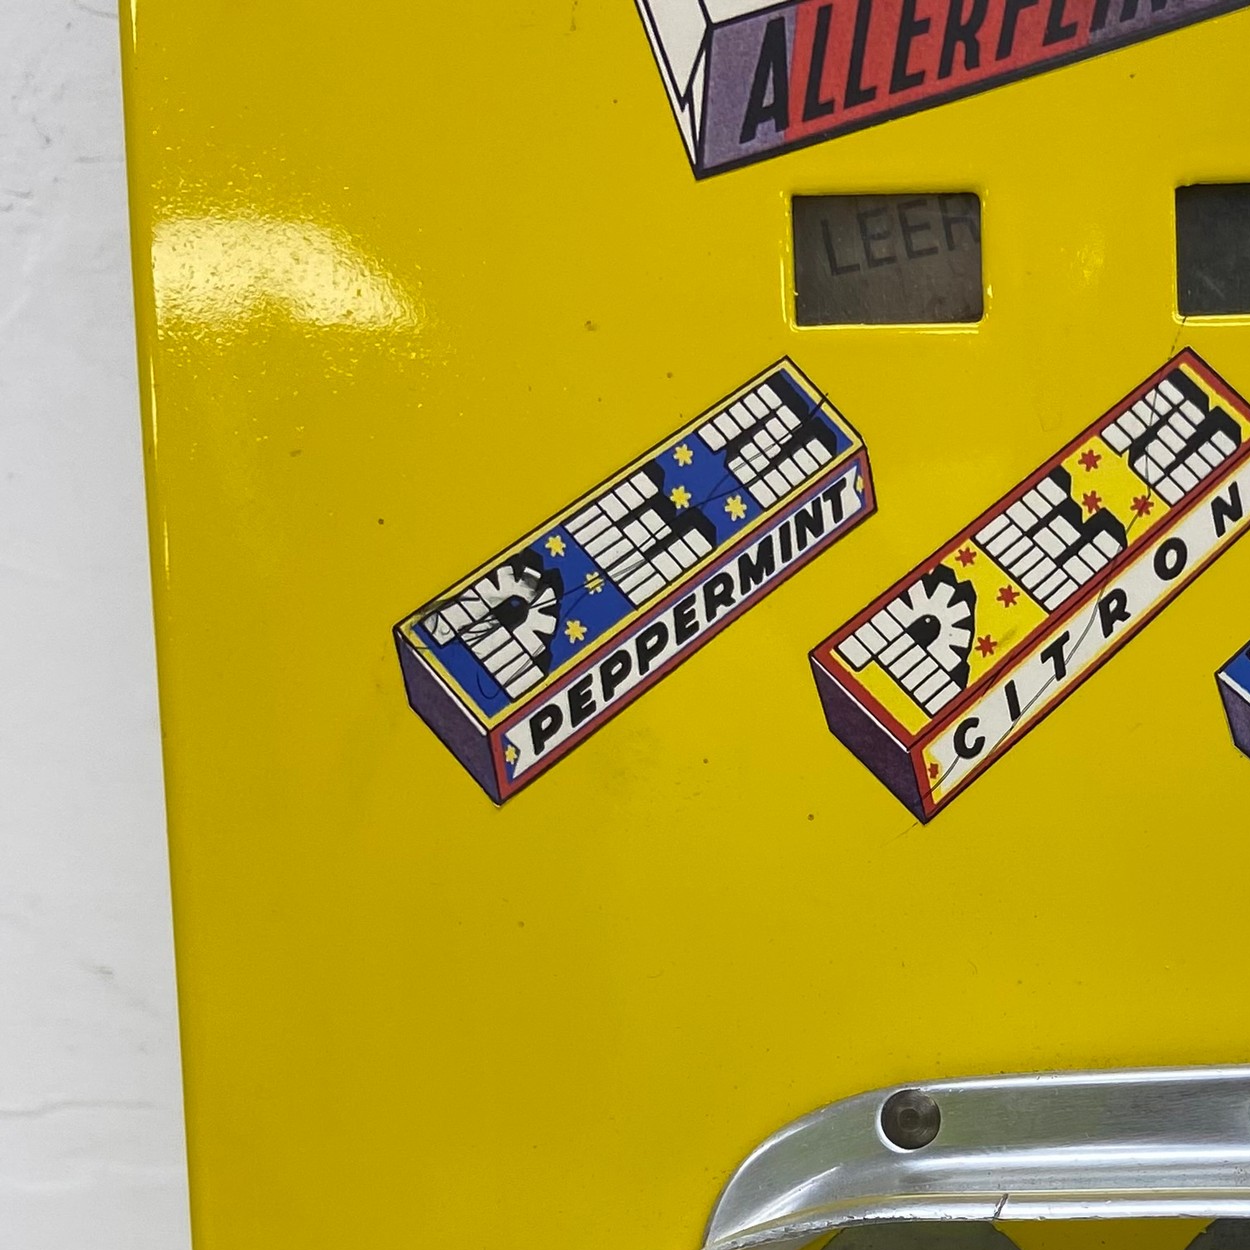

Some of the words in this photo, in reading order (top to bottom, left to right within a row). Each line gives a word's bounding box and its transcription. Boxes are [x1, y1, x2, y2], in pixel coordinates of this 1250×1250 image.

[423, 383, 833, 699] PEZ
[529, 477, 848, 756] PEPPERMINT
[837, 378, 1239, 718] PEZ
[953, 482, 1243, 759] CITRON
